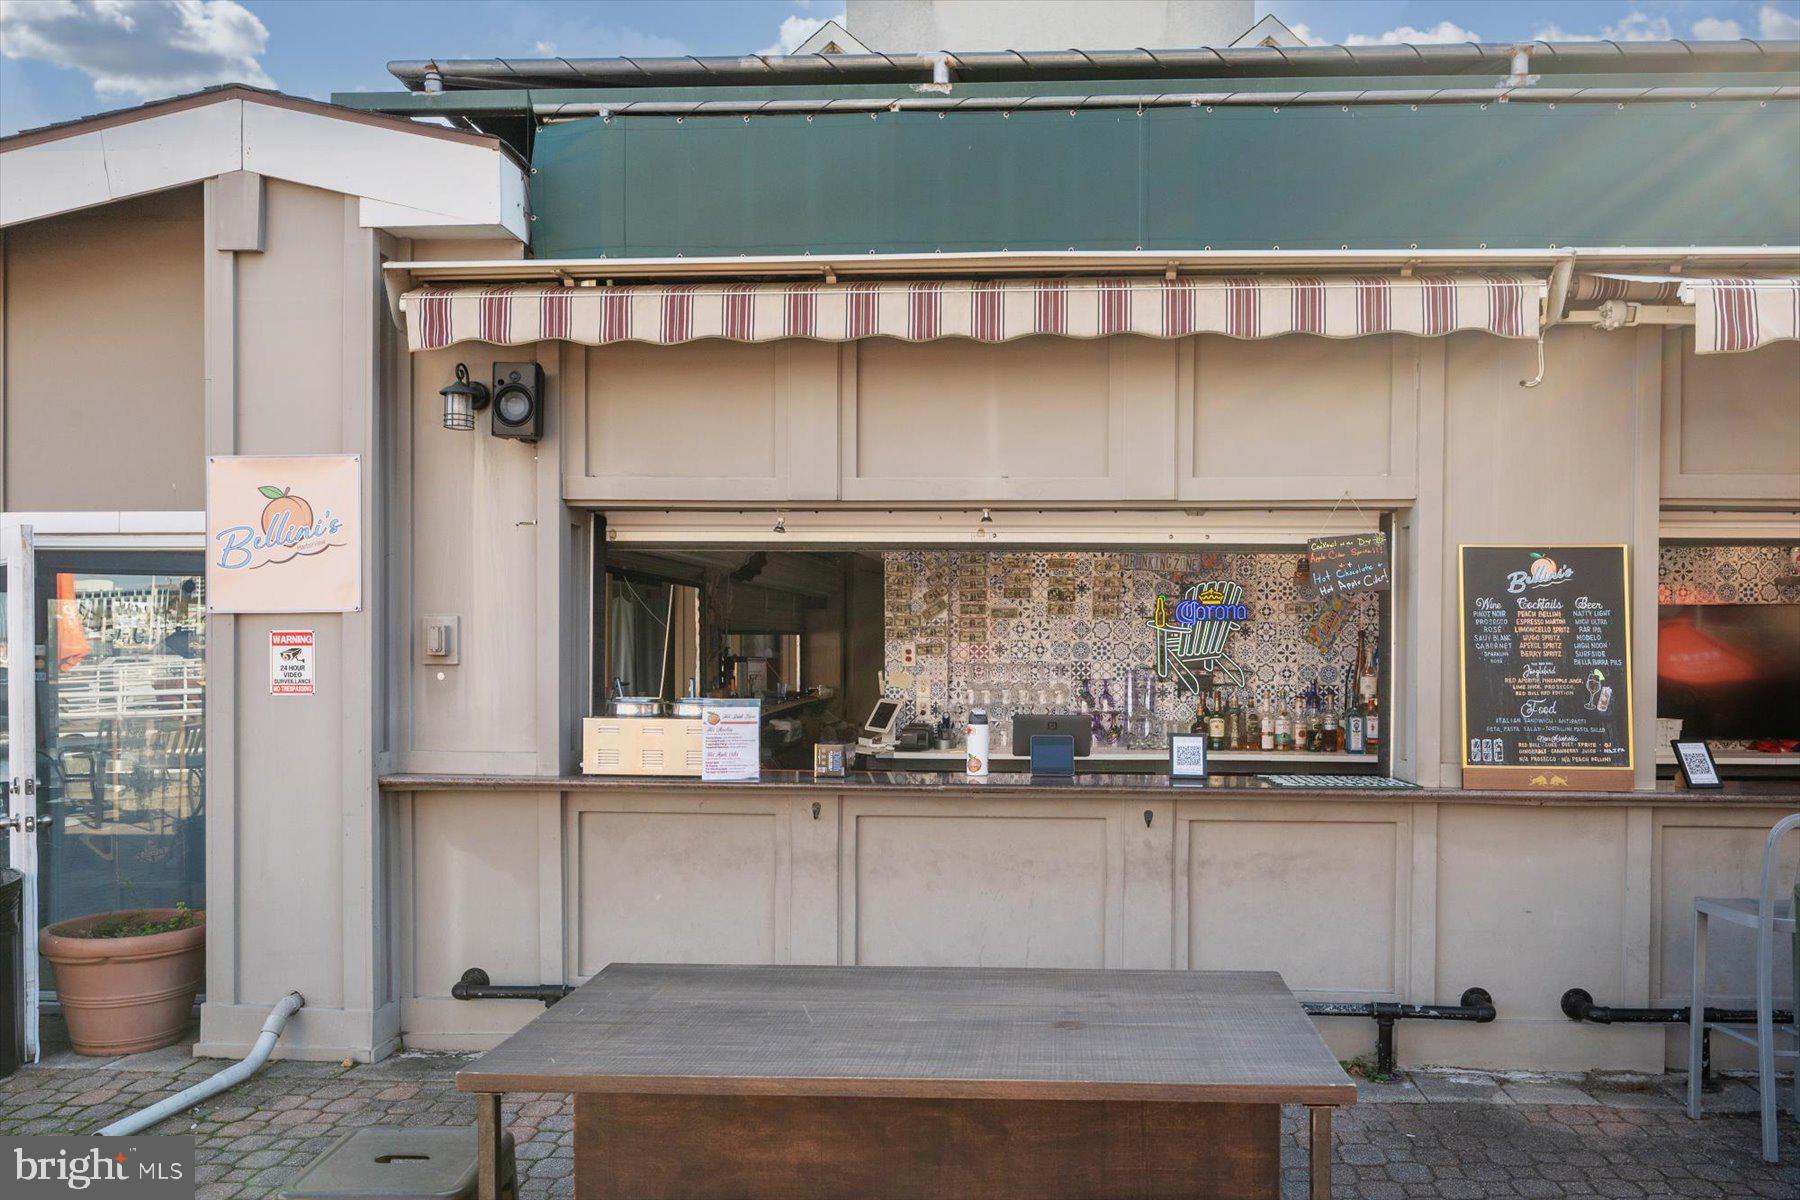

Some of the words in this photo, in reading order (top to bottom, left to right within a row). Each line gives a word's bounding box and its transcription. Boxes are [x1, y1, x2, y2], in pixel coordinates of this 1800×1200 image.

[215, 509, 343, 570] Bellini's
[1310, 539, 1337, 551] Cocktail
[1310, 552, 1326, 563] Apple
[1312, 570, 1331, 585] Hot
[1336, 564, 1374, 578] Chocolate
[1506, 564, 1575, 594] Bellini's
[1319, 585, 1334, 596] Hot
[1337, 579, 1361, 591] Apple
[1363, 568, 1390, 588] Cider!
[1475, 597, 1502, 610] Wine
[1516, 596, 1564, 611] Cocktails
[1575, 596, 1604, 610] Beer
[1175, 599, 1247, 627] Corona
[1517, 610, 1537, 618] PEACH
[1593, 609, 1611, 617] LIGHT
[1516, 618, 1544, 626] ESPRESSO
[272, 634, 313, 645] WARNING
[1492, 634, 1511, 642] BLANC
[1574, 658, 1592, 666] BELLA
[1520, 698, 1557, 718] Food
